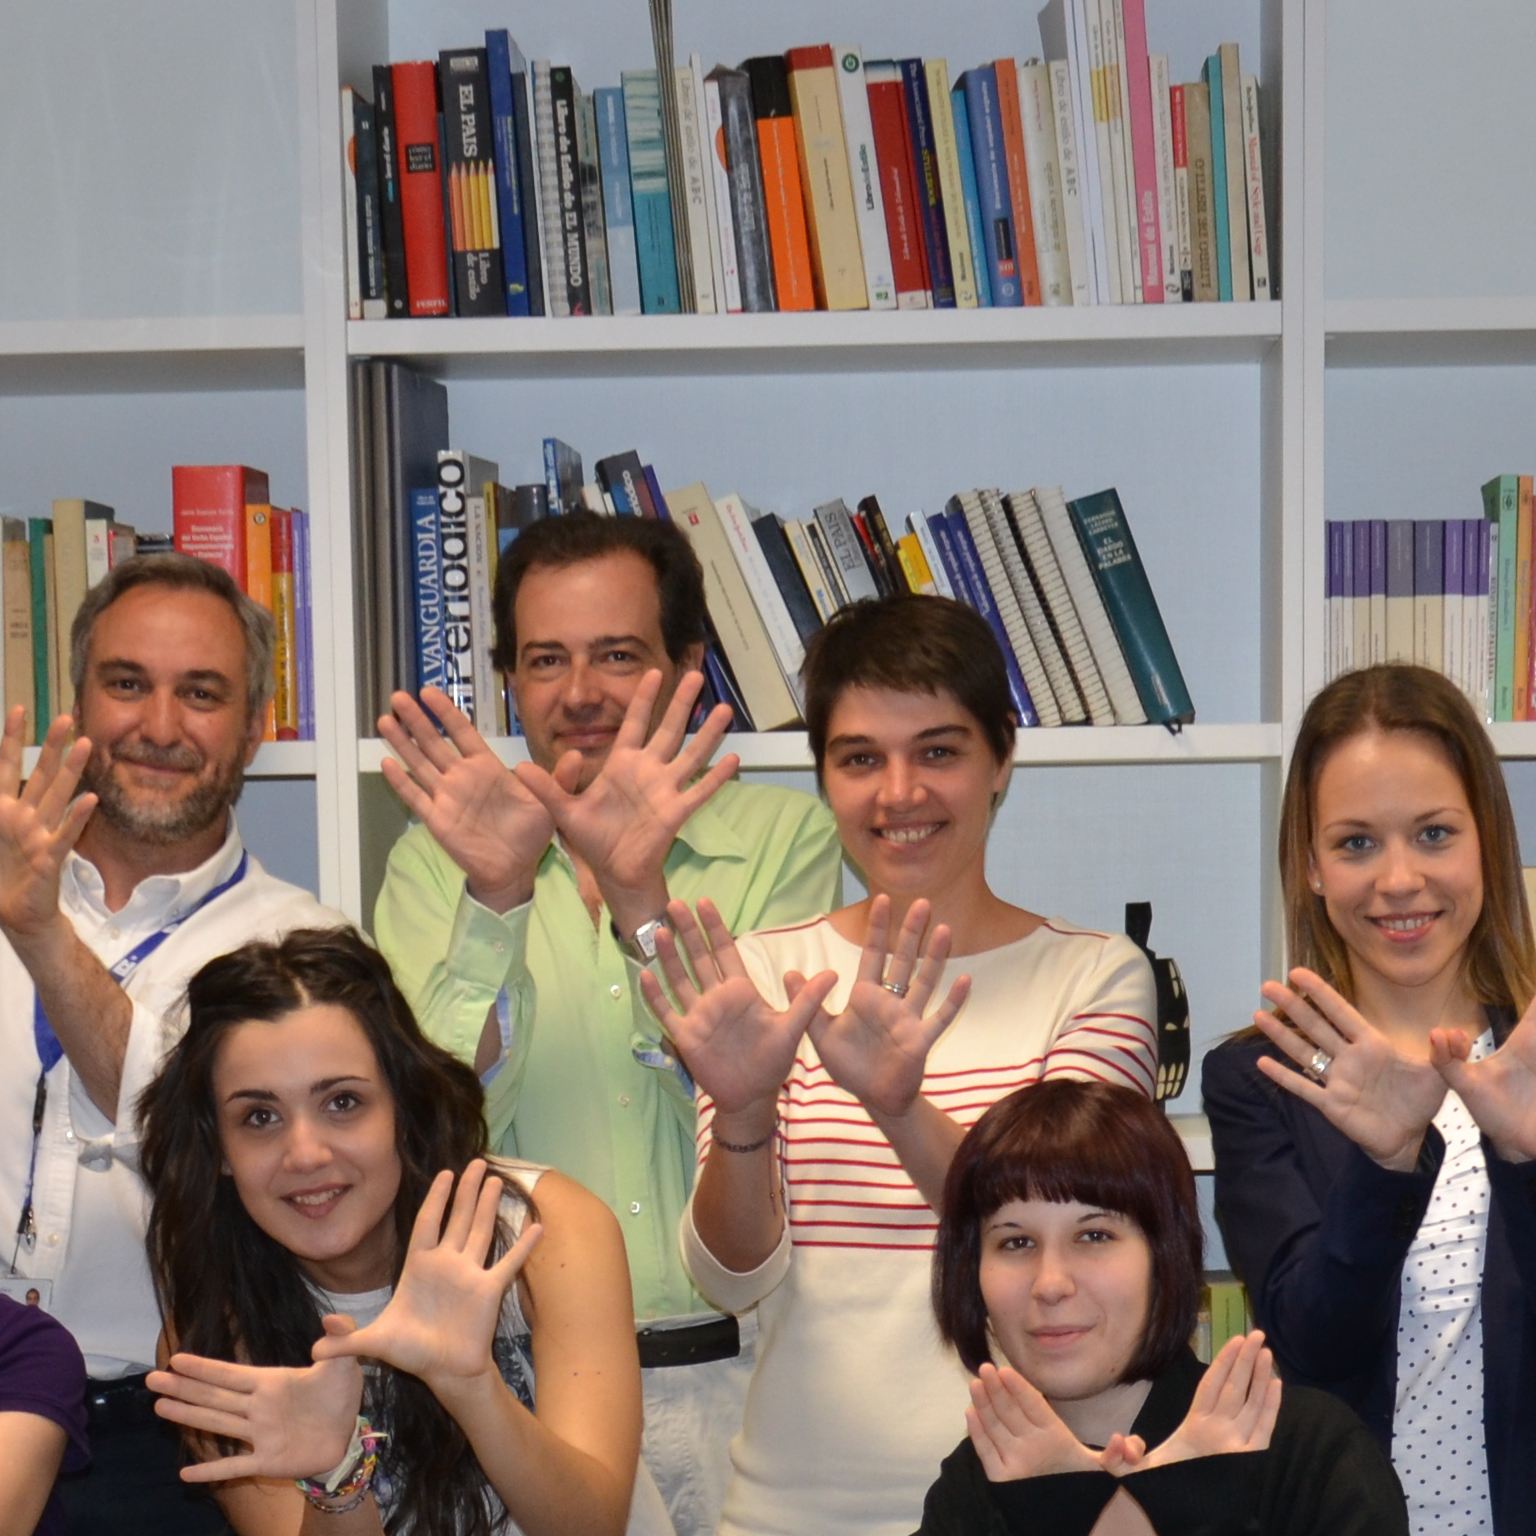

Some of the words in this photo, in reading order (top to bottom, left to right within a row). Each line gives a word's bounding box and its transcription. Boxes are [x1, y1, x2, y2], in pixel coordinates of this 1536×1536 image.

[458, 83, 475, 112] EL
[557, 100, 573, 133] Libro
[691, 175, 703, 205] ABC
[1065, 167, 1078, 197] ABC
[1195, 158, 1208, 215] ESTILO
[565, 211, 579, 230] EL
[1141, 190, 1155, 223] Estilo
[1143, 225, 1156, 241] de
[1197, 216, 1209, 238] DE
[479, 252, 490, 284] Libro
[567, 232, 582, 286] MUNDO
[1144, 244, 1160, 287] Manual
[1198, 240, 1212, 289] LIBRO
[1096, 540, 1125, 555] DARDO
[1101, 551, 1114, 563] EN
[1113, 547, 1125, 559] LA
[1102, 536, 1113, 546] EL
[840, 553, 856, 574] EL
[1097, 554, 1133, 571] PALABRA
[415, 512, 443, 674] VANGUARDIA
